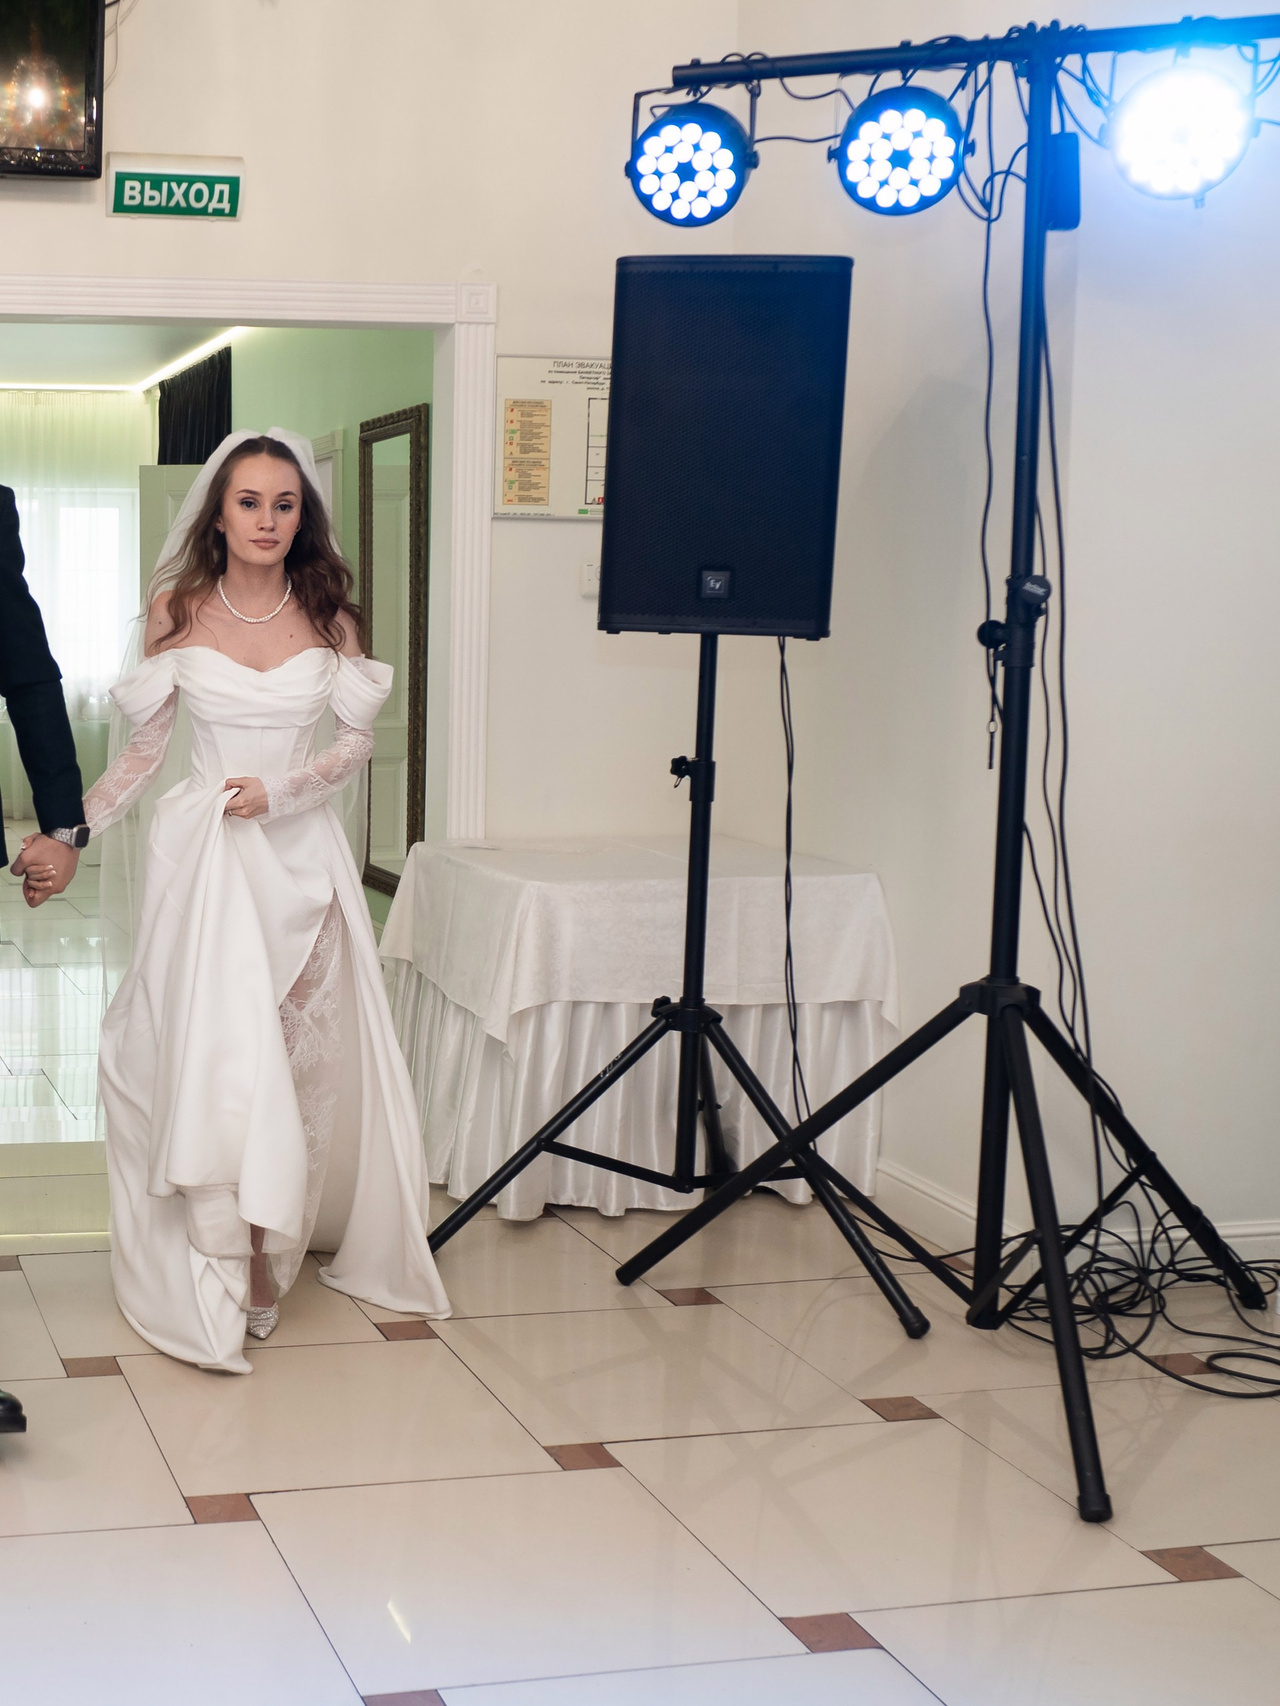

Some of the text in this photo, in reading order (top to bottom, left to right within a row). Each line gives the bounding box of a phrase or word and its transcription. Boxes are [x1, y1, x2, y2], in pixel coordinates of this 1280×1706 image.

[122, 179, 231, 214] ВЫХОД
[552, 360, 611, 370] ПЛАН ЭВАКУАЦ
